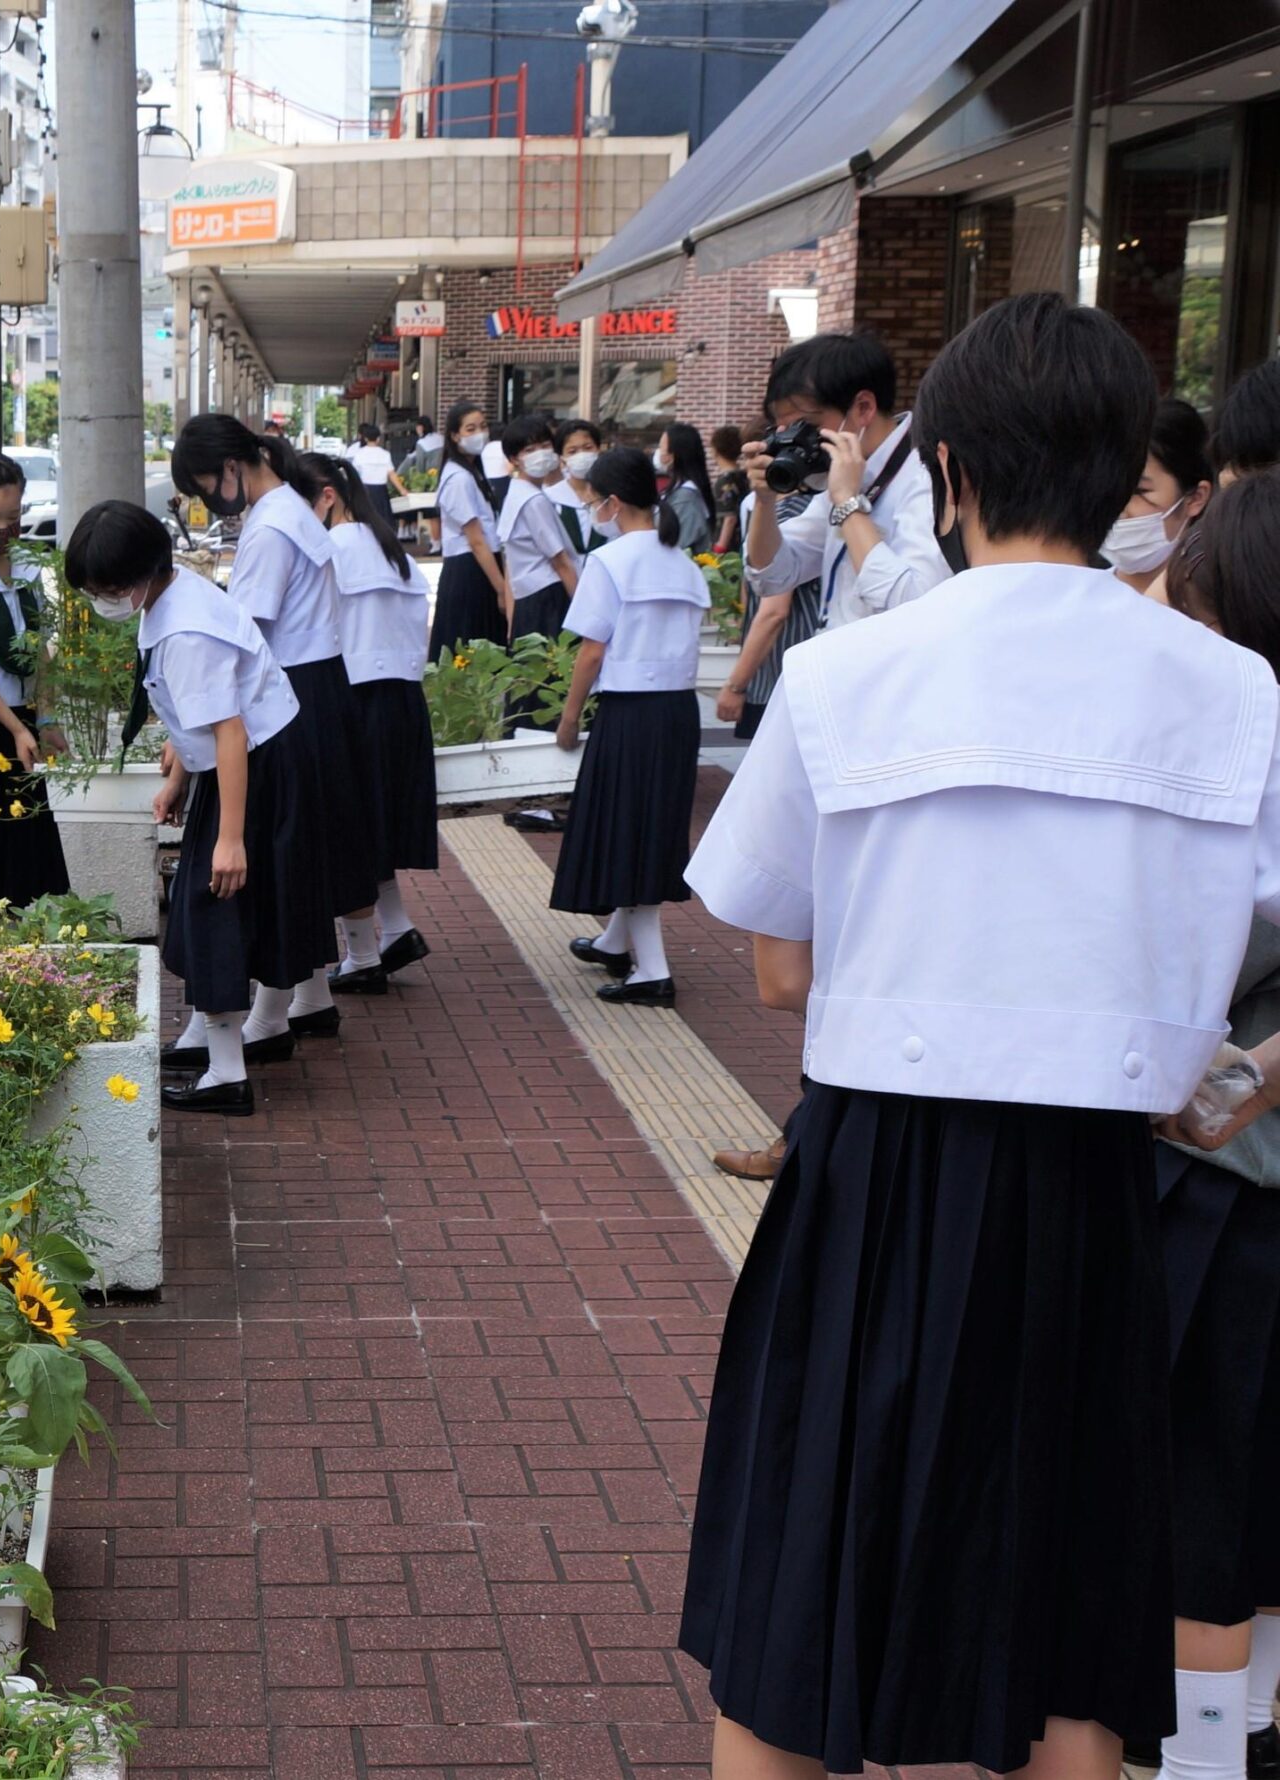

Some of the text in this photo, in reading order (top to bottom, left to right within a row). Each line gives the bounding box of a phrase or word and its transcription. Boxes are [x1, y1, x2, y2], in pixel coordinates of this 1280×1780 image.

[174, 177, 276, 201] るく楽しいショッピングゾーン
[510, 307, 546, 340] VIE
[600, 309, 677, 336] RANCE
